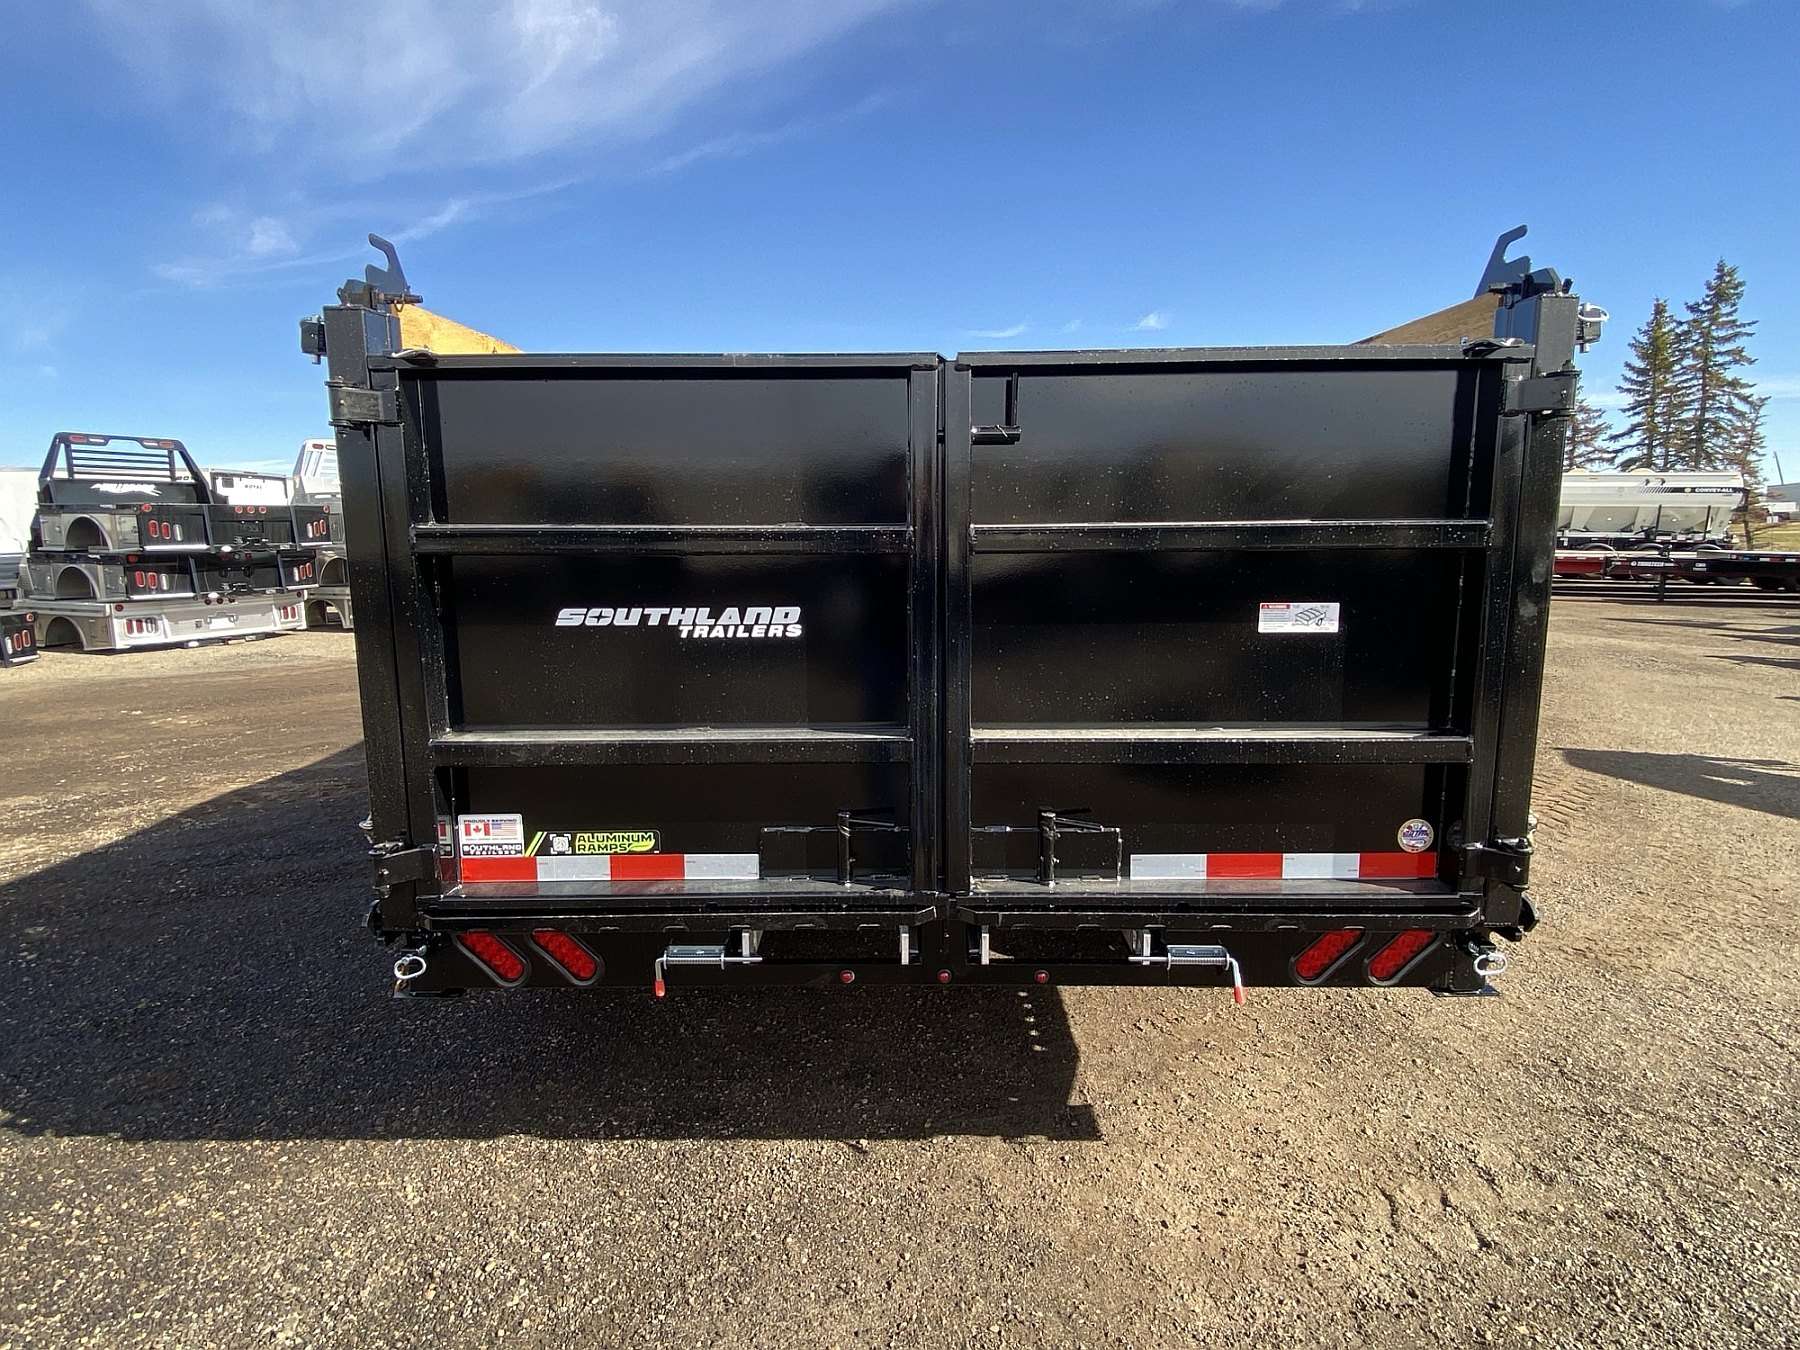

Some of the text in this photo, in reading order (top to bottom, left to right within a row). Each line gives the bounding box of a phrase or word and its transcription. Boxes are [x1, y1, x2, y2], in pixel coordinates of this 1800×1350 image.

[555, 606, 801, 627] SOUTHLAND
[678, 624, 802, 639] TRAILERS
[577, 833, 654, 843] ALUMINUM
[577, 843, 629, 852] RAMPS
